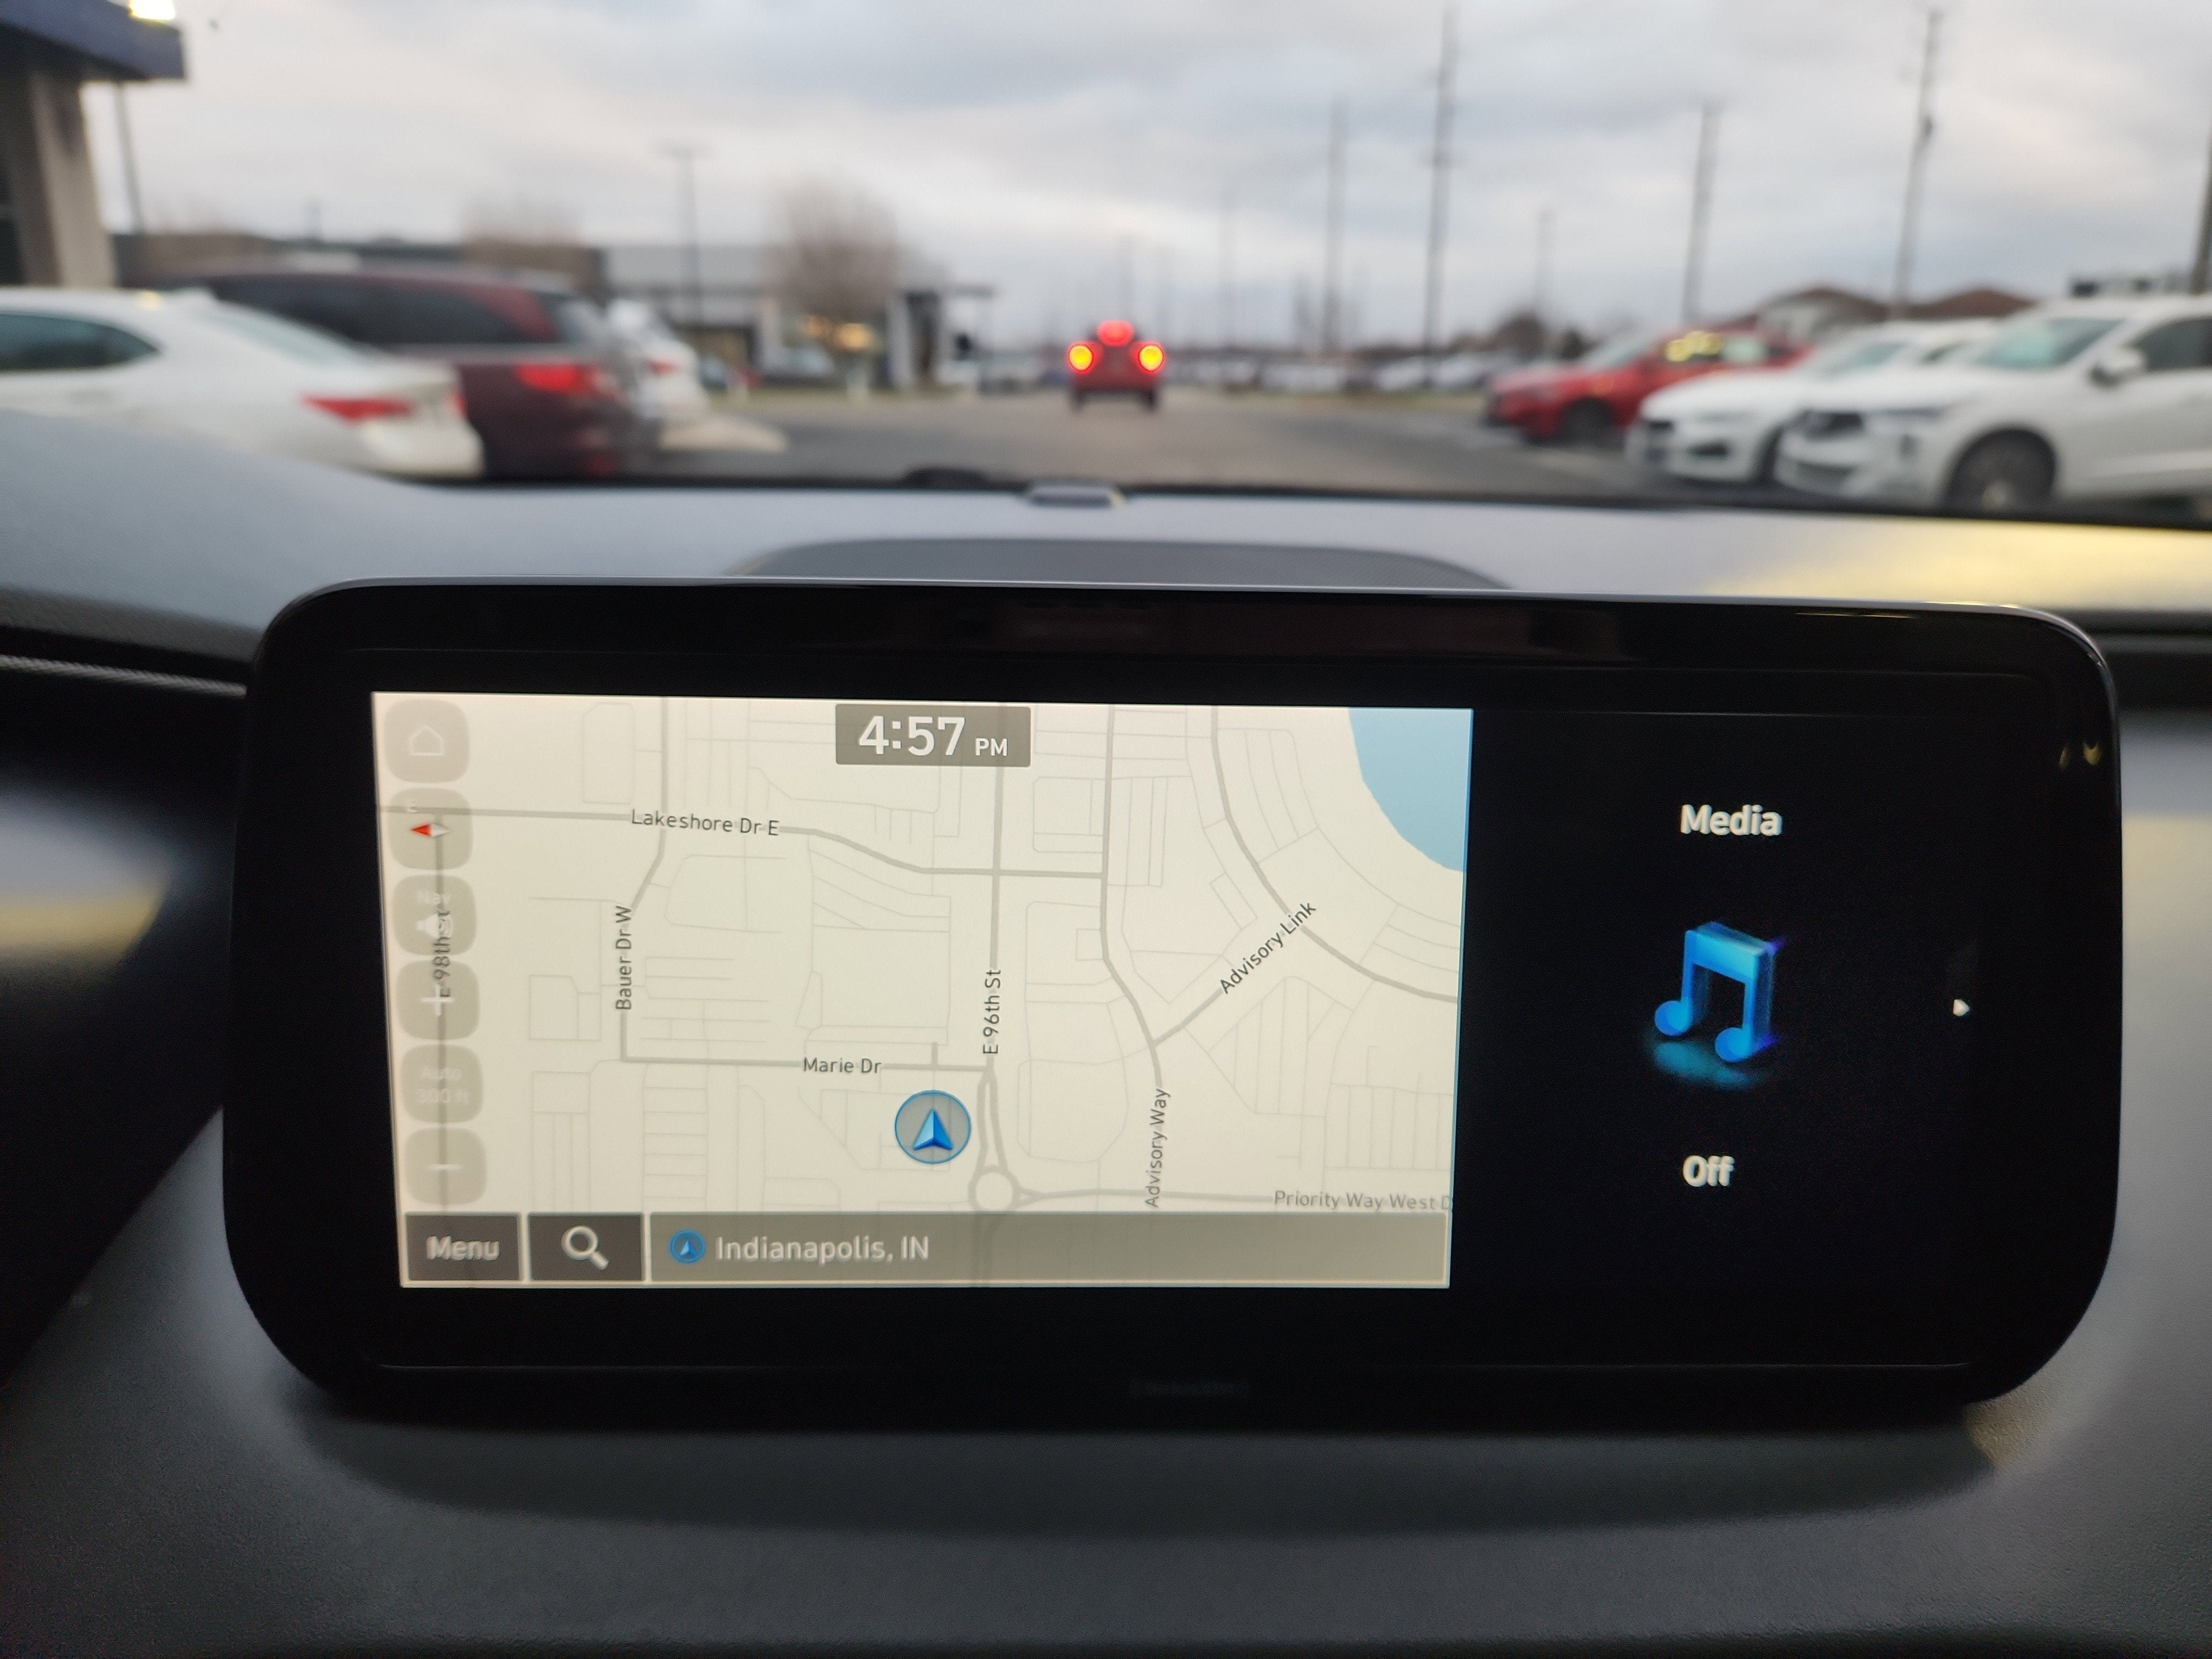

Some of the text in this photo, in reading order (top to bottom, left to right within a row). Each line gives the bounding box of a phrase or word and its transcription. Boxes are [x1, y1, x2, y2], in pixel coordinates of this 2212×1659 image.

[858, 716, 1008, 757] 4:57 PM
[631, 809, 781, 836] Lakeshore Dr E
[1681, 805, 1782, 836] Media
[434, 936, 451, 981] 98th
[615, 905, 633, 1010] Bauer Dr W
[1219, 901, 1317, 994] Advisory Link
[982, 969, 1002, 1056] E 96th St
[803, 1057, 882, 1074] Marie Dr
[1144, 1088, 1172, 1208] Advisory Way
[1683, 1155, 1734, 1187] Off
[1275, 1190, 1340, 1210] Priority
[1346, 1192, 1384, 1211] Way
[1390, 1193, 1436, 1211] West
[427, 1235, 500, 1261] Menu
[716, 1236, 929, 1265] Indianapolis, IN
